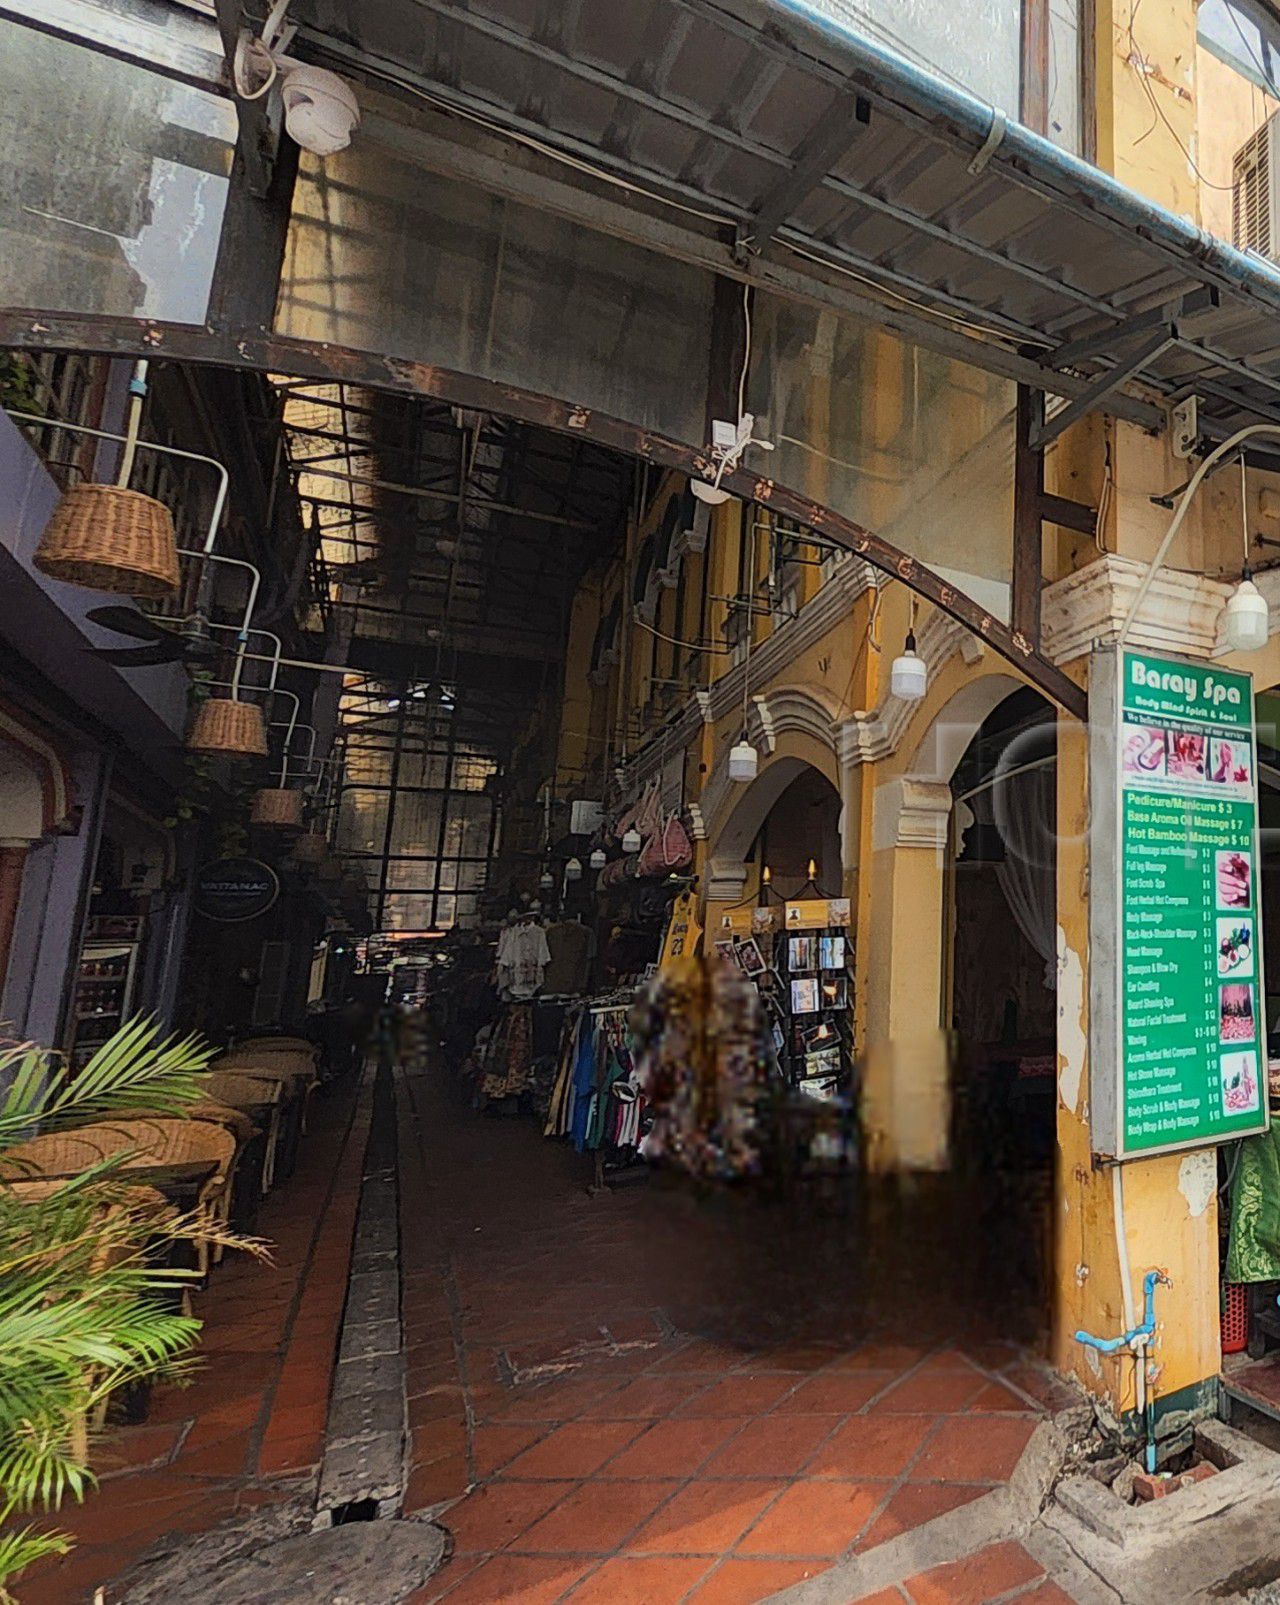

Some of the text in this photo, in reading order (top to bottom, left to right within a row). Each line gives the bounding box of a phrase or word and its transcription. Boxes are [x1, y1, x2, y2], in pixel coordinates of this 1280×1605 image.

[1132, 660, 1240, 706] Baray Spa
[1135, 696, 1159, 710] Body
[1161, 700, 1184, 713] Mind
[1186, 704, 1208, 717] Spirit
[1210, 710, 1216, 719] &
[1140, 714, 1161, 726] believe
[1163, 718, 1170, 727] in
[1171, 720, 1181, 729] the
[1182, 722, 1204, 734] quality
[1205, 726, 1211, 735] of
[1224, 731, 1246, 740] service
[1127, 792, 1232, 814] Pedicure/Manicure $ 3
[1127, 810, 1243, 831] Base Aroma Oil Massage $ 7
[1128, 827, 1249, 846] Hot Bamboo Massage $ 10
[1141, 912, 1163, 924] Massage
[1176, 928, 1197, 940] Massage
[1141, 946, 1163, 958] Massage
[1162, 1013, 1186, 1024] Treatment
[1154, 1067, 1176, 1078] Massage
[1157, 1082, 1182, 1094] Treatment
[1178, 1098, 1200, 1109] Massage
[1177, 1116, 1199, 1128] Massage
